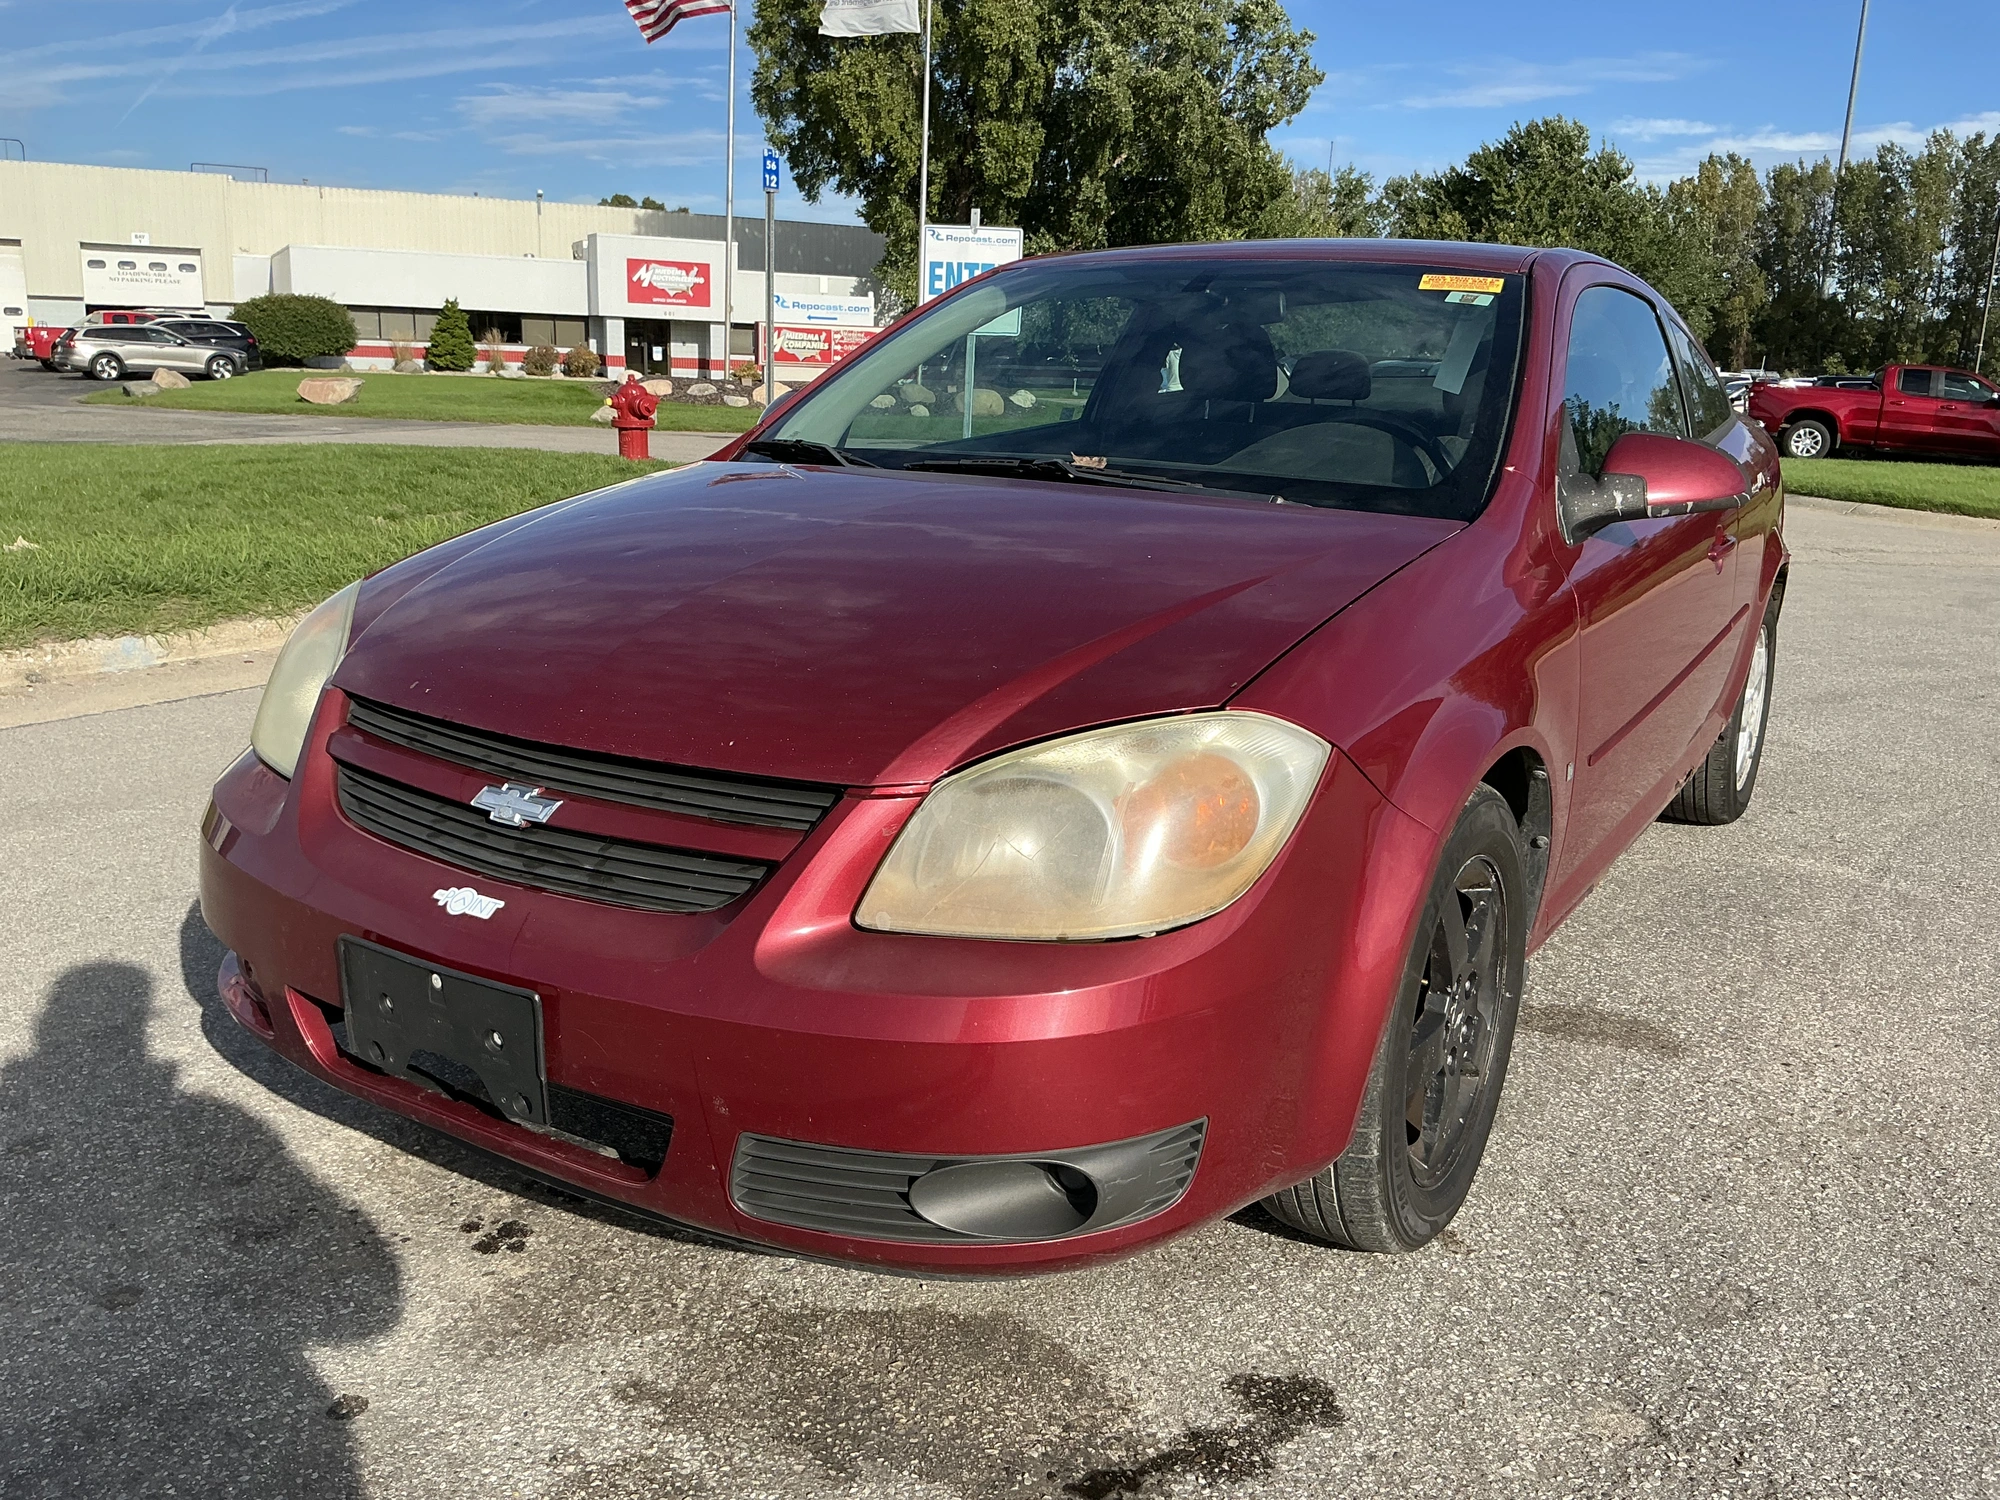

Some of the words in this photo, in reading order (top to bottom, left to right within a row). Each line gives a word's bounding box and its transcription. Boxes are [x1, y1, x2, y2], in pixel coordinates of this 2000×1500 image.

[766, 160, 777, 170] 56
[765, 174, 777, 187] 12
[946, 235, 1017, 244] Repocast.com
[929, 261, 1002, 295] ENT
[792, 302, 870, 312] Repocast.com
[785, 332, 819, 340] MIEDEMA
[784, 341, 829, 350] COMPANIES
